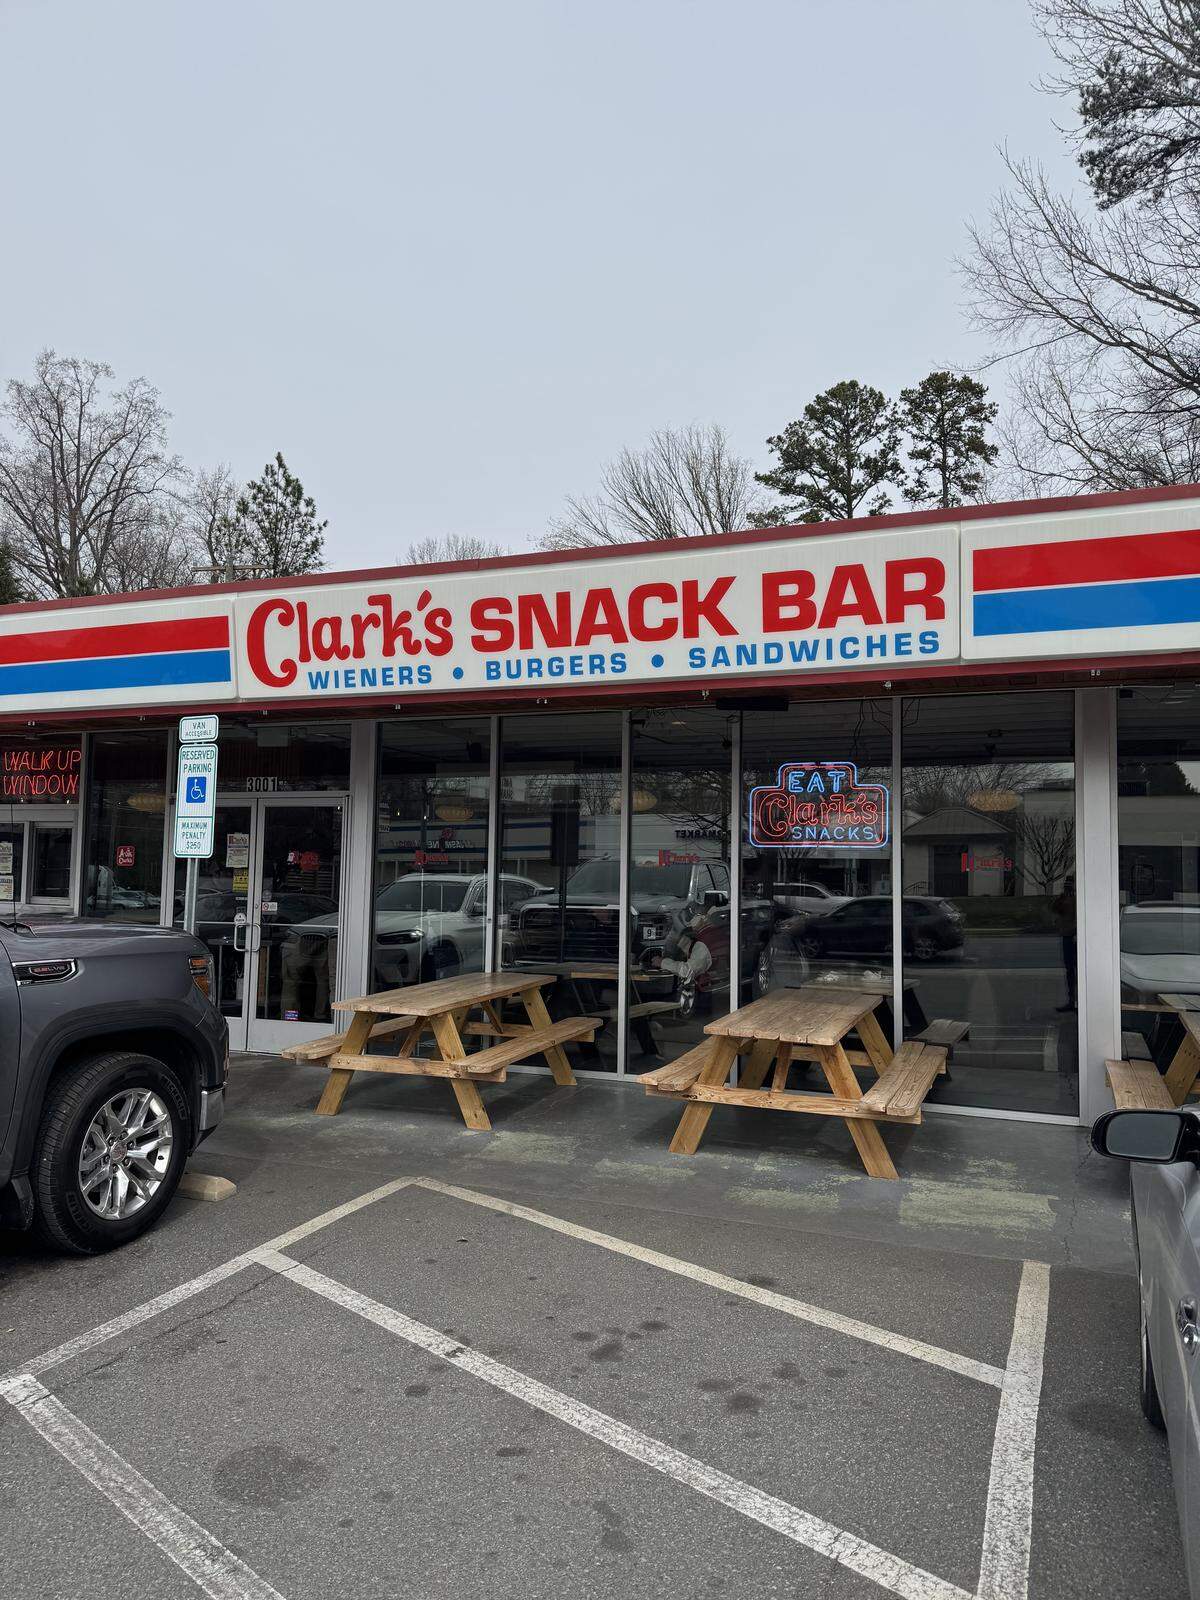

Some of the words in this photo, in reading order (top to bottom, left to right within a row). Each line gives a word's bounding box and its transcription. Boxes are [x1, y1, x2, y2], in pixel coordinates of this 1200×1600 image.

[247, 590, 454, 688] Clark's
[470, 575, 740, 653] SNACK
[762, 557, 946, 633] BAR
[308, 664, 433, 690] WIENERS
[485, 652, 628, 681] BURGERS
[689, 630, 940, 669] SANDWICHES
[185, 729, 213, 737] ACCESSIBLE
[192, 721, 206, 730] VAN
[4, 750, 54, 771] WALK
[57, 750, 82, 771] UP
[181, 749, 215, 761] RESERVED
[183, 762, 212, 774] PARKING
[3, 774, 79, 796] WINDOW
[247, 776, 278, 792] 3001
[788, 771, 846, 793] EAT
[759, 792, 879, 837] Clark's
[181, 821, 208, 830] MAXIMUM
[181, 831, 207, 840] PENALTY
[791, 826, 876, 841] SNACKS
[185, 841, 202, 850] $250
